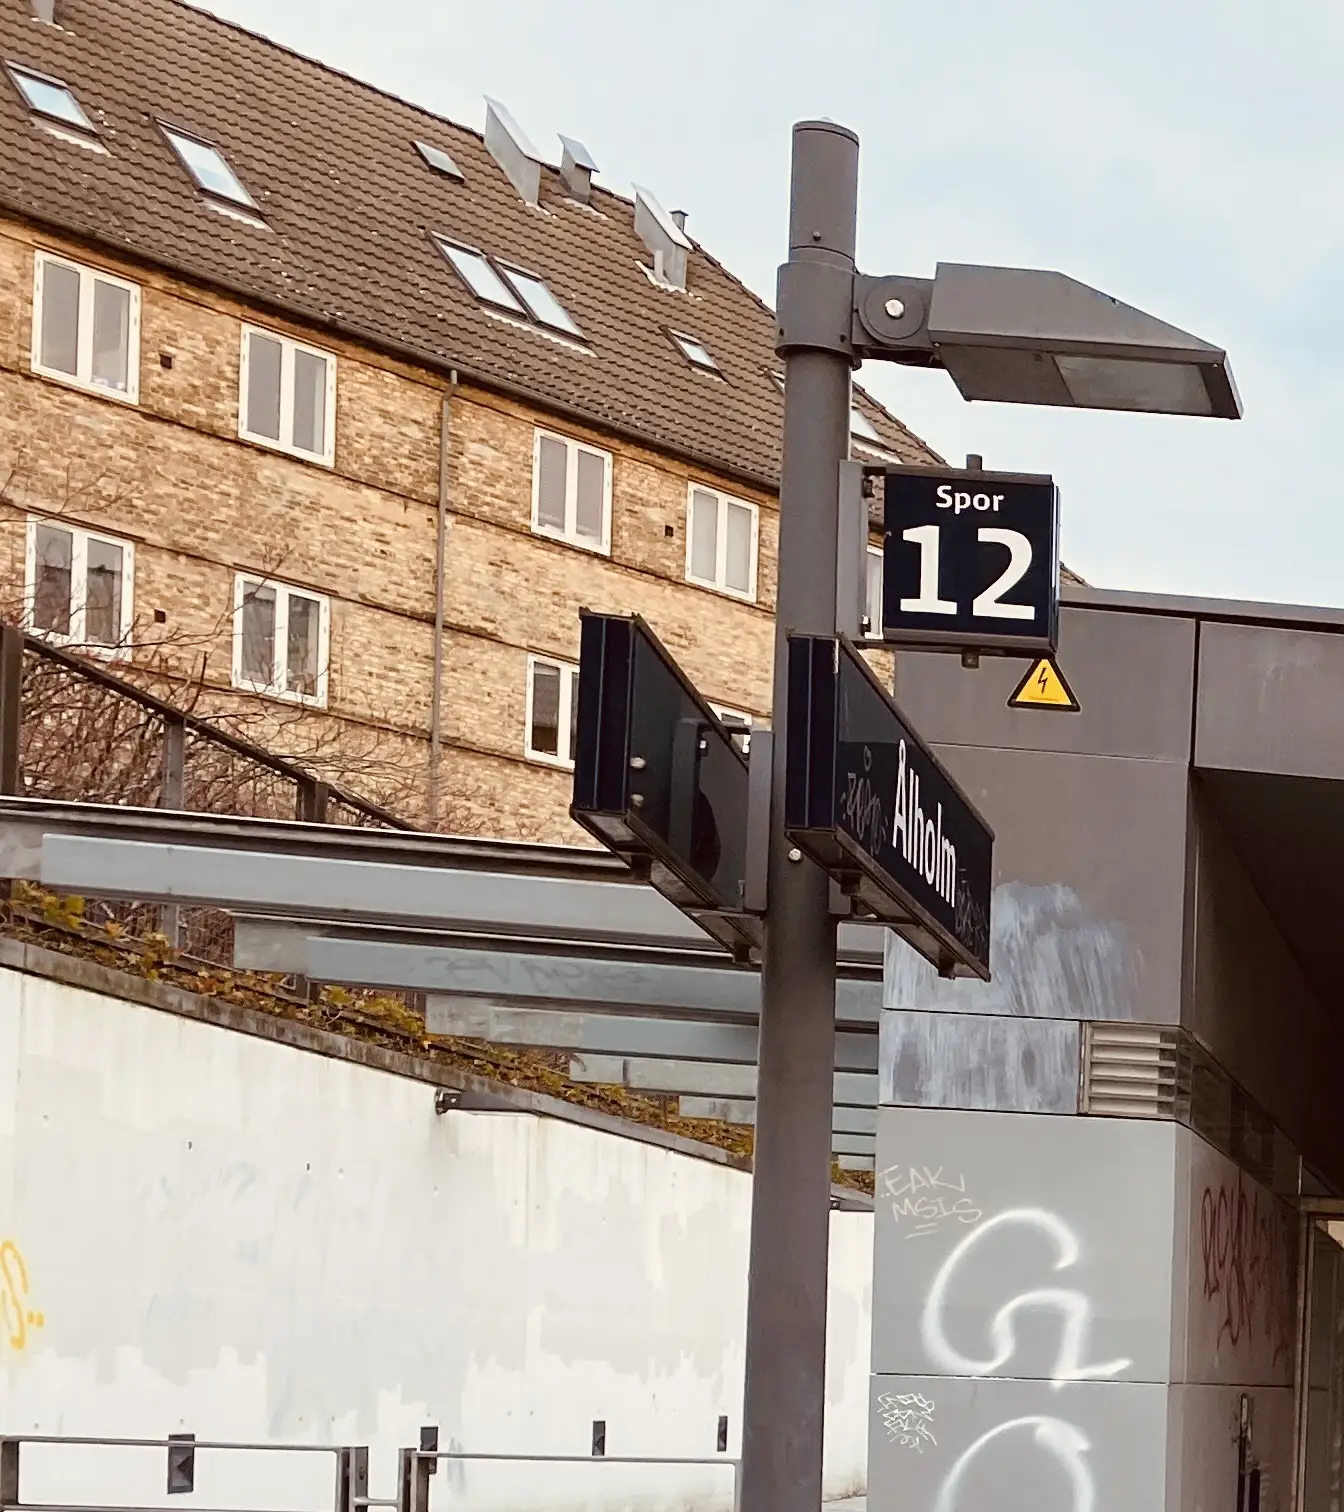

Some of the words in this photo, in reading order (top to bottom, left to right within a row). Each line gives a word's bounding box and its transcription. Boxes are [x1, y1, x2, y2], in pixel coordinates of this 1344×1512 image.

[936, 485, 1005, 515] Spor
[900, 525, 1036, 621] 12
[892, 739, 956, 908] Ålholm
